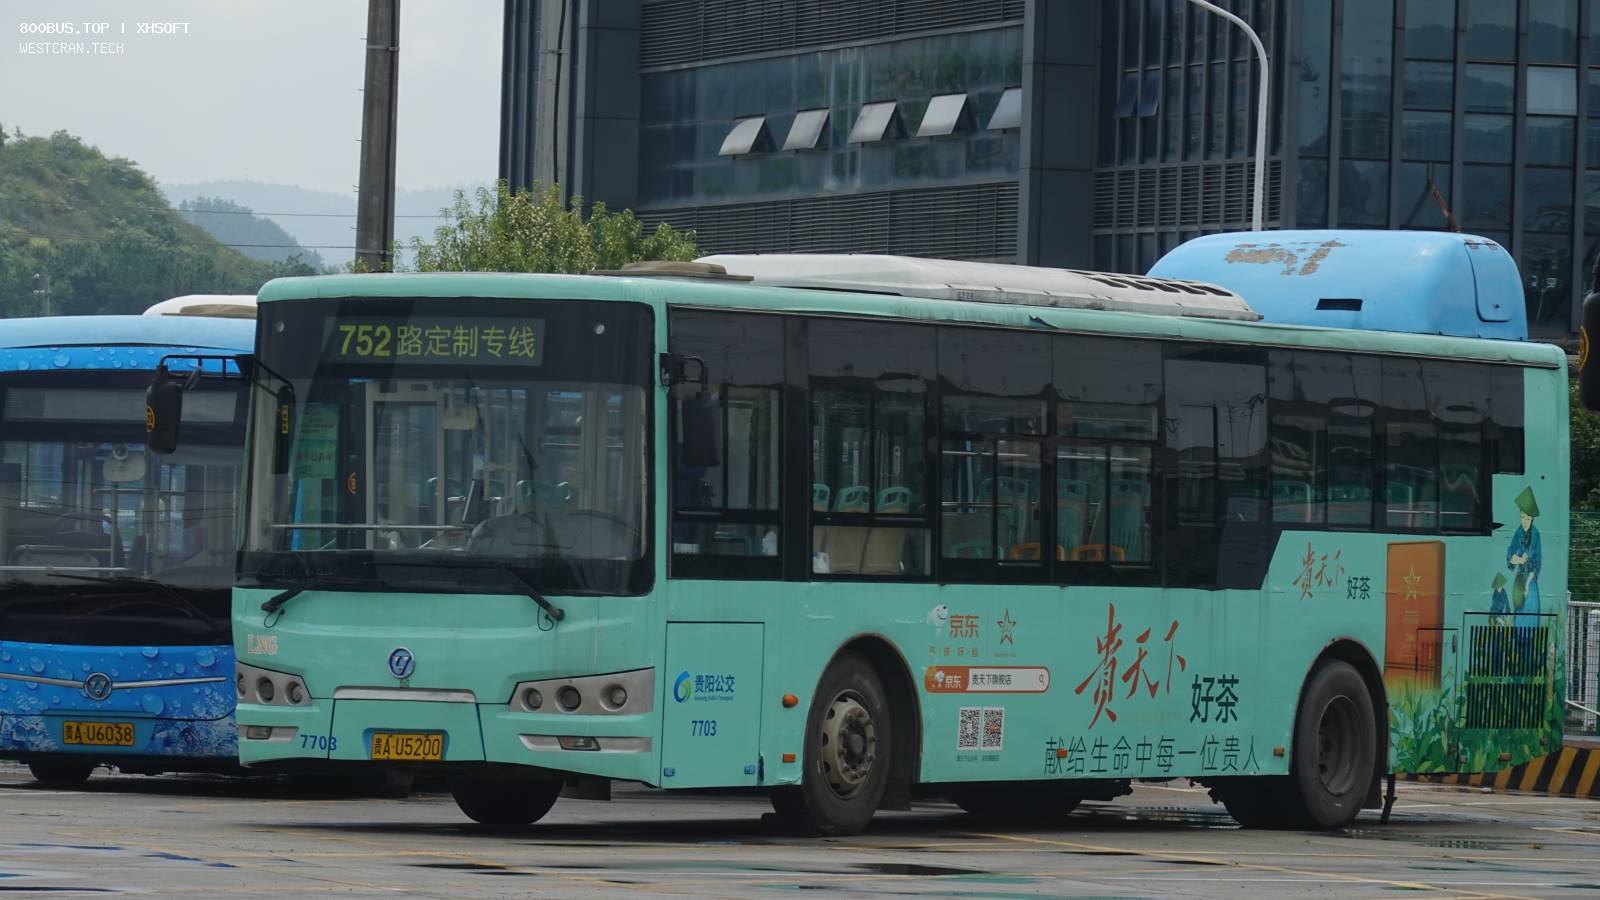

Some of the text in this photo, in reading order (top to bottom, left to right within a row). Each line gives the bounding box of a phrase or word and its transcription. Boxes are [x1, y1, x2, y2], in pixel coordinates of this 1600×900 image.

[339, 324, 536, 358] 752路定制专线
[1347, 575, 1371, 600] 好茶
[949, 614, 980, 639] 京东
[247, 634, 278, 655] LNG
[694, 674, 736, 693] 贵阳公交
[1190, 674, 1240, 724] 好茶
[691, 720, 717, 737] 7703
[299, 734, 337, 751] 7703
[1044, 735, 1261, 774] 献给生命中每一位贵人
